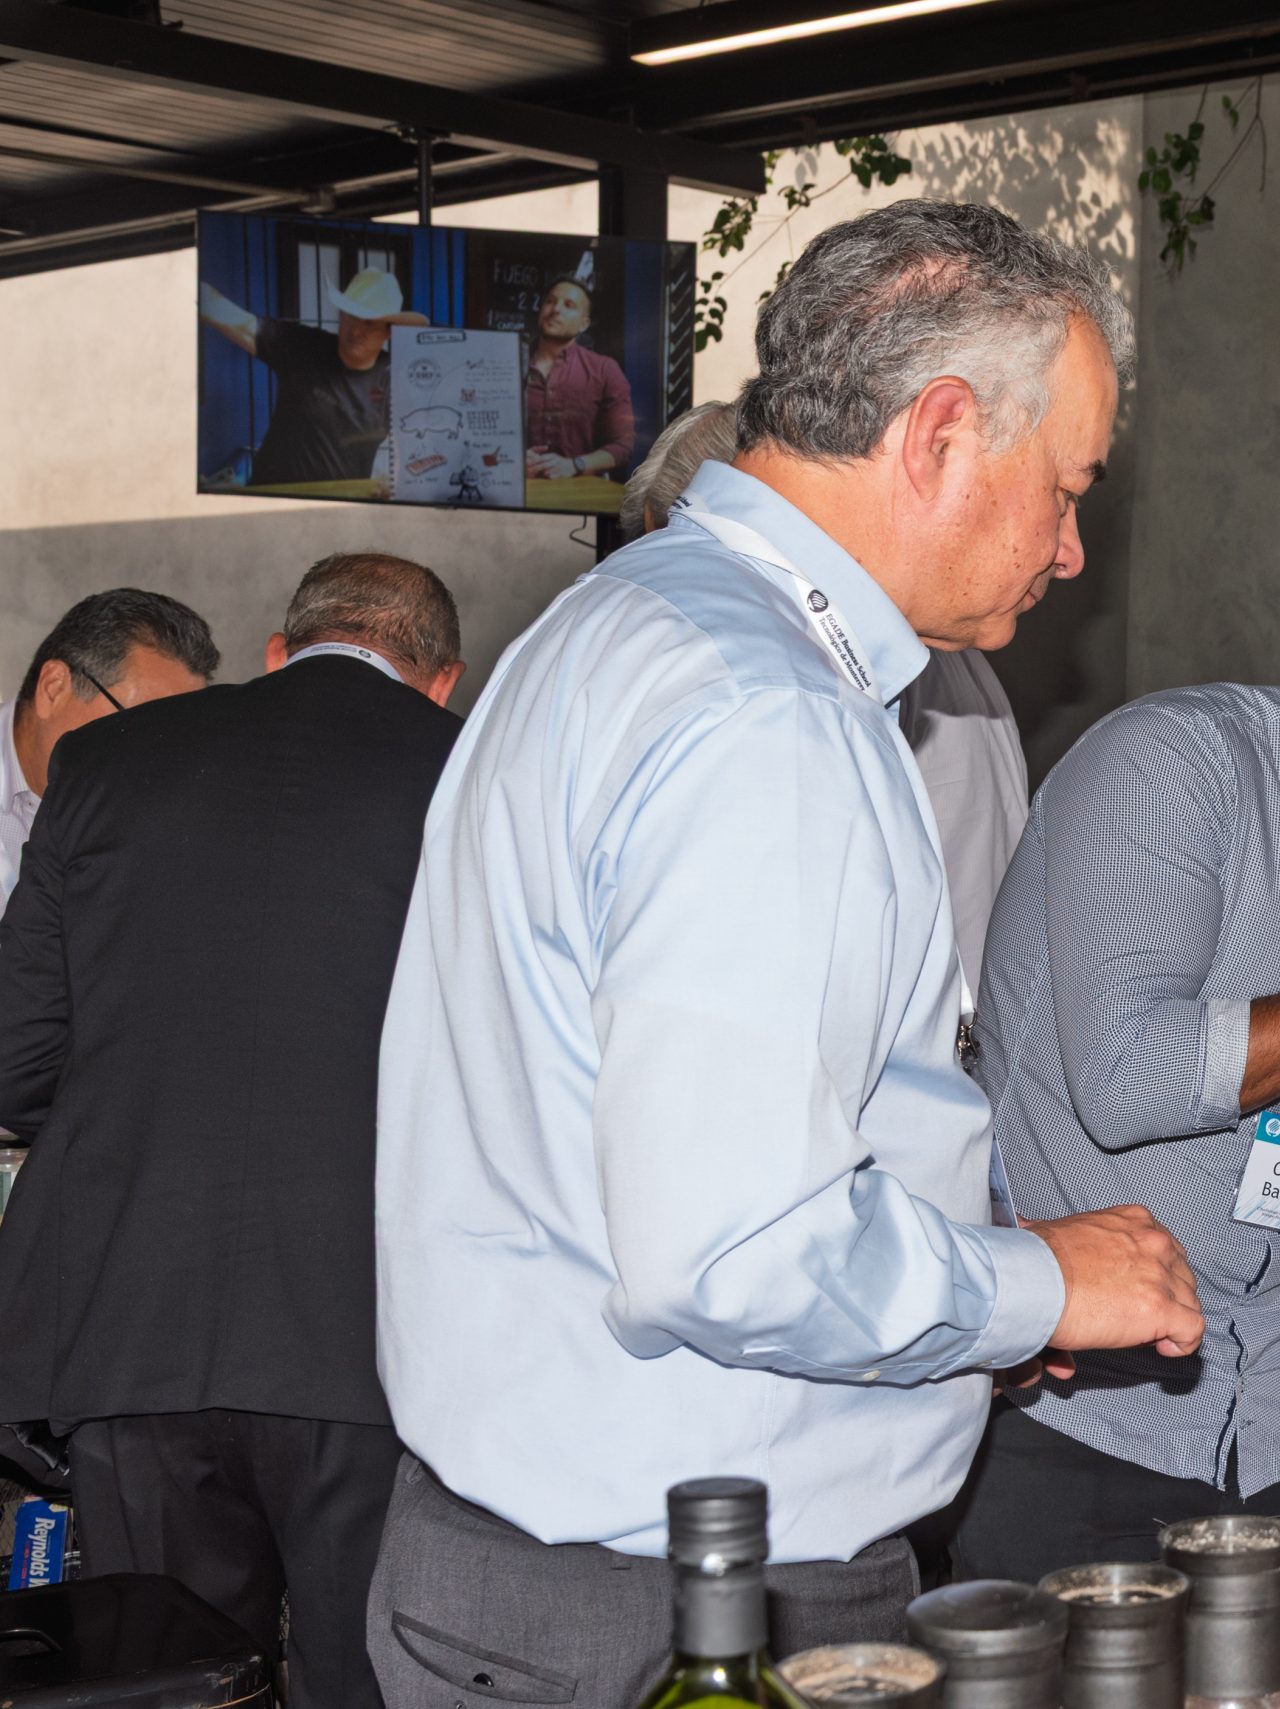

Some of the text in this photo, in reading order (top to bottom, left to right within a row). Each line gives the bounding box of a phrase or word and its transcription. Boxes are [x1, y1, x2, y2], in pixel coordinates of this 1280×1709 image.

[826, 613, 872, 688] EGADE Business School
[840, 653, 848, 662] de
[845, 660, 865, 691] Monterrey
[27, 1517, 56, 1577] Reynolds
